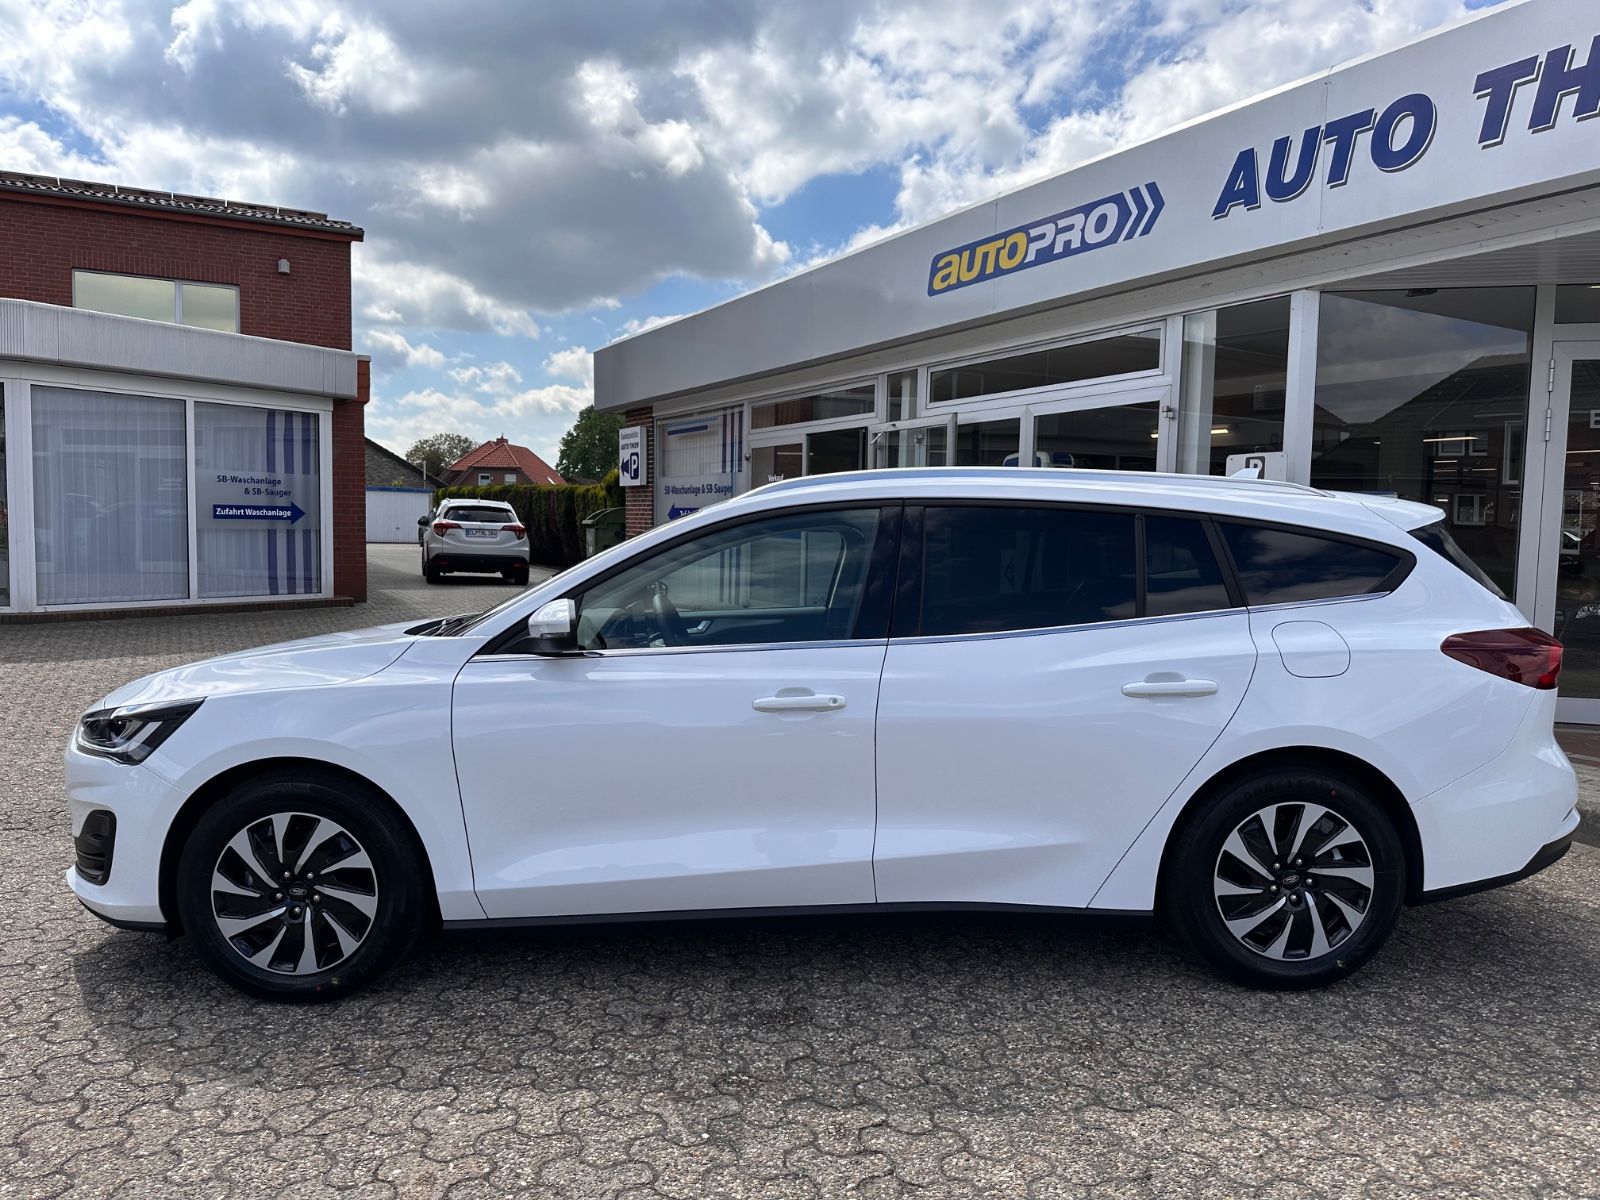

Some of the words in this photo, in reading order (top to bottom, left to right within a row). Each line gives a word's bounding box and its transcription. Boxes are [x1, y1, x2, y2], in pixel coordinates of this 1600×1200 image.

[1211, 93, 1438, 220] AUTO
[1472, 34, 1600, 150] TH
[631, 455, 638, 477] P
[216, 475, 281, 486] SB-Waschanlage
[244, 487, 250, 495] &
[251, 488, 292, 497] SB-Sauger
[664, 485, 700, 496] SB-Waschanlage
[701, 484, 705, 493] &
[706, 483, 732, 495] SB-Sauger
[216, 507, 244, 515] Zufahrt
[245, 508, 291, 517] Waschanlage
